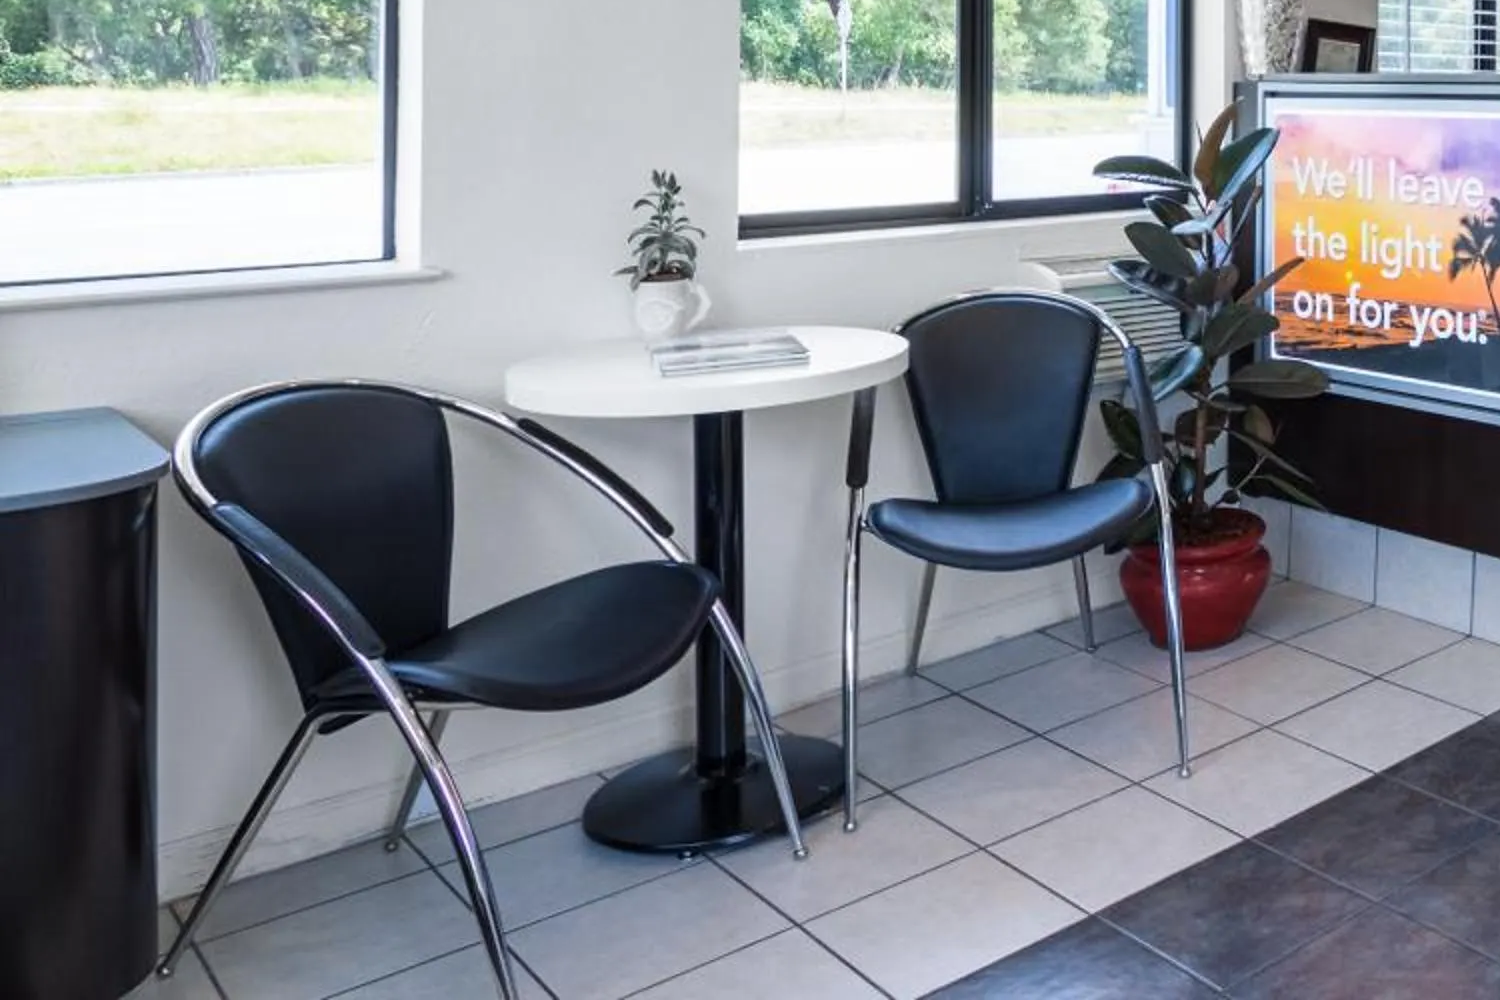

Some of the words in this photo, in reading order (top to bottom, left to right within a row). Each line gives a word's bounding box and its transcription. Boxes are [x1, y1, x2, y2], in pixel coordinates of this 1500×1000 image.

[1291, 155, 1374, 201] We'll
[1389, 158, 1484, 207] leave
[1292, 216, 1347, 261] the
[1361, 221, 1443, 279] light
[1293, 289, 1335, 322] on
[1346, 282, 1400, 330] for
